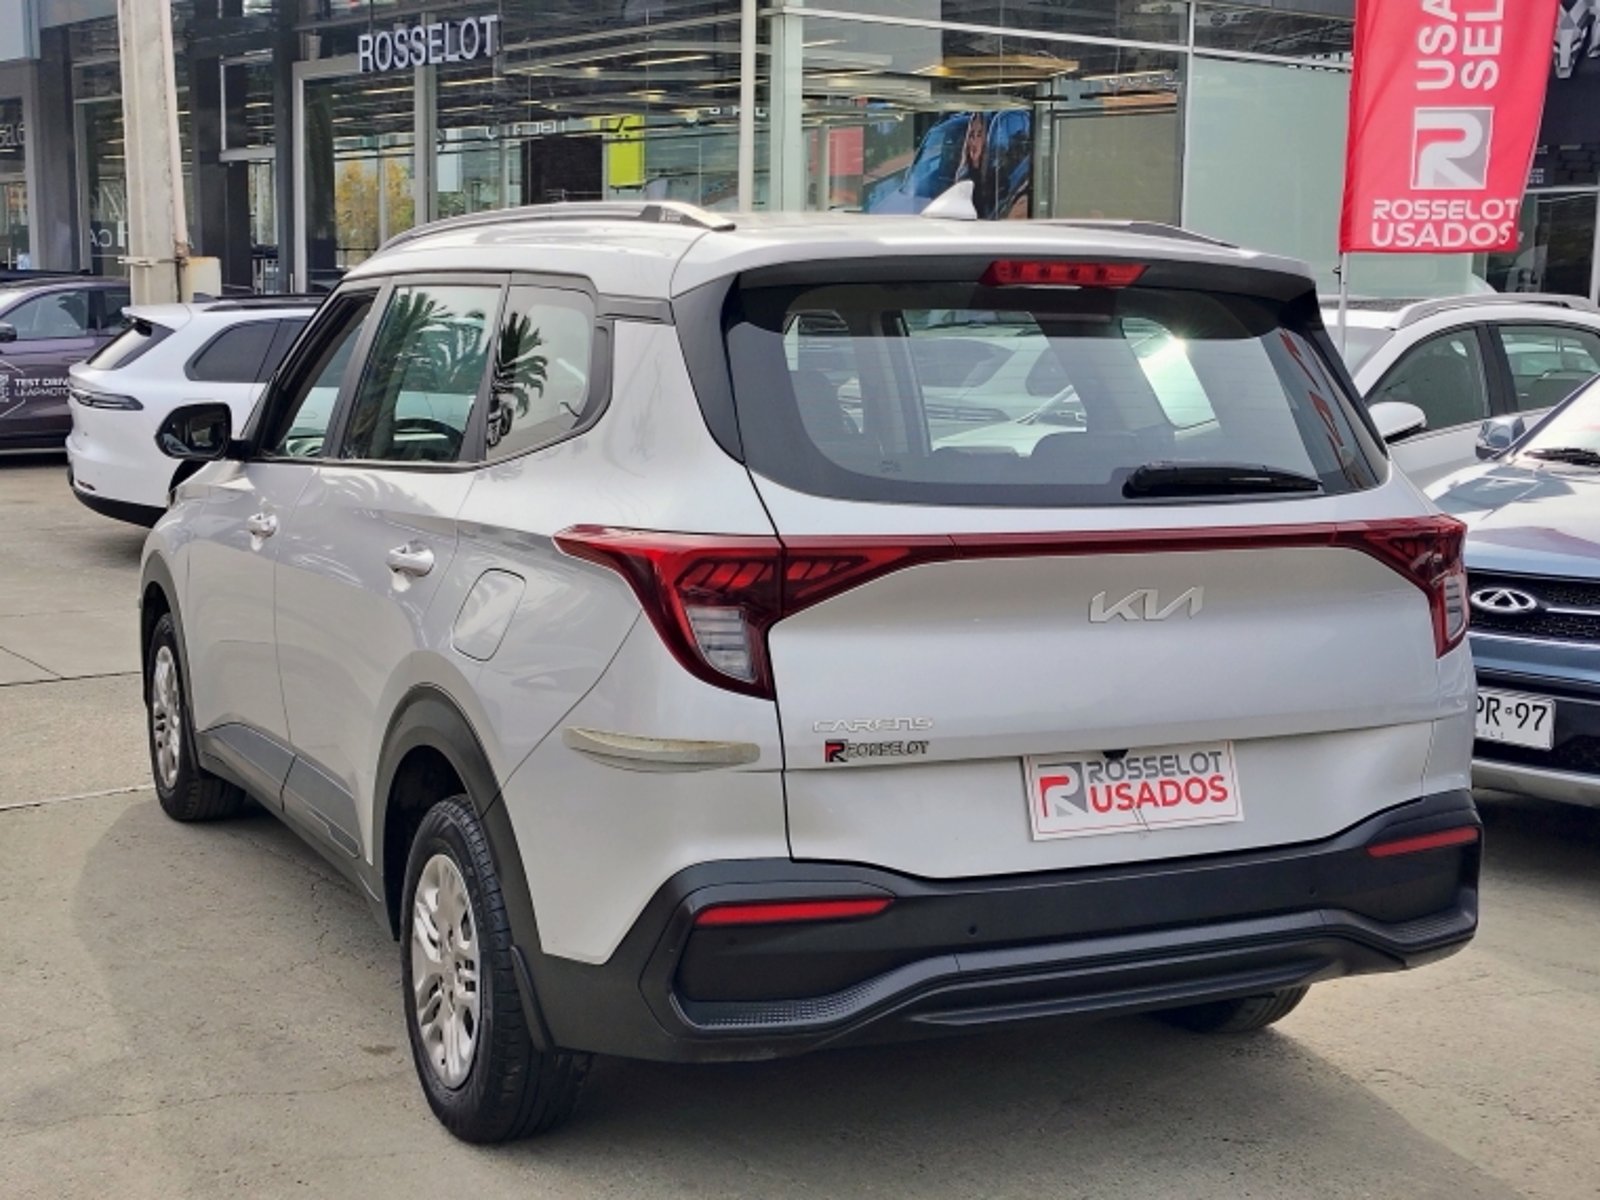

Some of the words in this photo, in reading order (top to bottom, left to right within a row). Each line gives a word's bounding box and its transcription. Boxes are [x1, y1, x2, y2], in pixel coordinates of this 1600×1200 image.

[358, 14, 498, 73] ROSSELOT
[1416, 0, 1458, 91] USA
[1461, 0, 1504, 91] SEL
[1372, 199, 1519, 220] ROSSELOT
[1371, 221, 1514, 247] USADOS
[14, 378, 41, 387] TEST
[42, 378, 69, 387] DRIV
[14, 387, 71, 397] LEAPMOTO
[1088, 586, 1204, 623] KIA
[1086, 751, 1223, 783] ROSSELOT
[1089, 774, 1229, 814] USADOS
